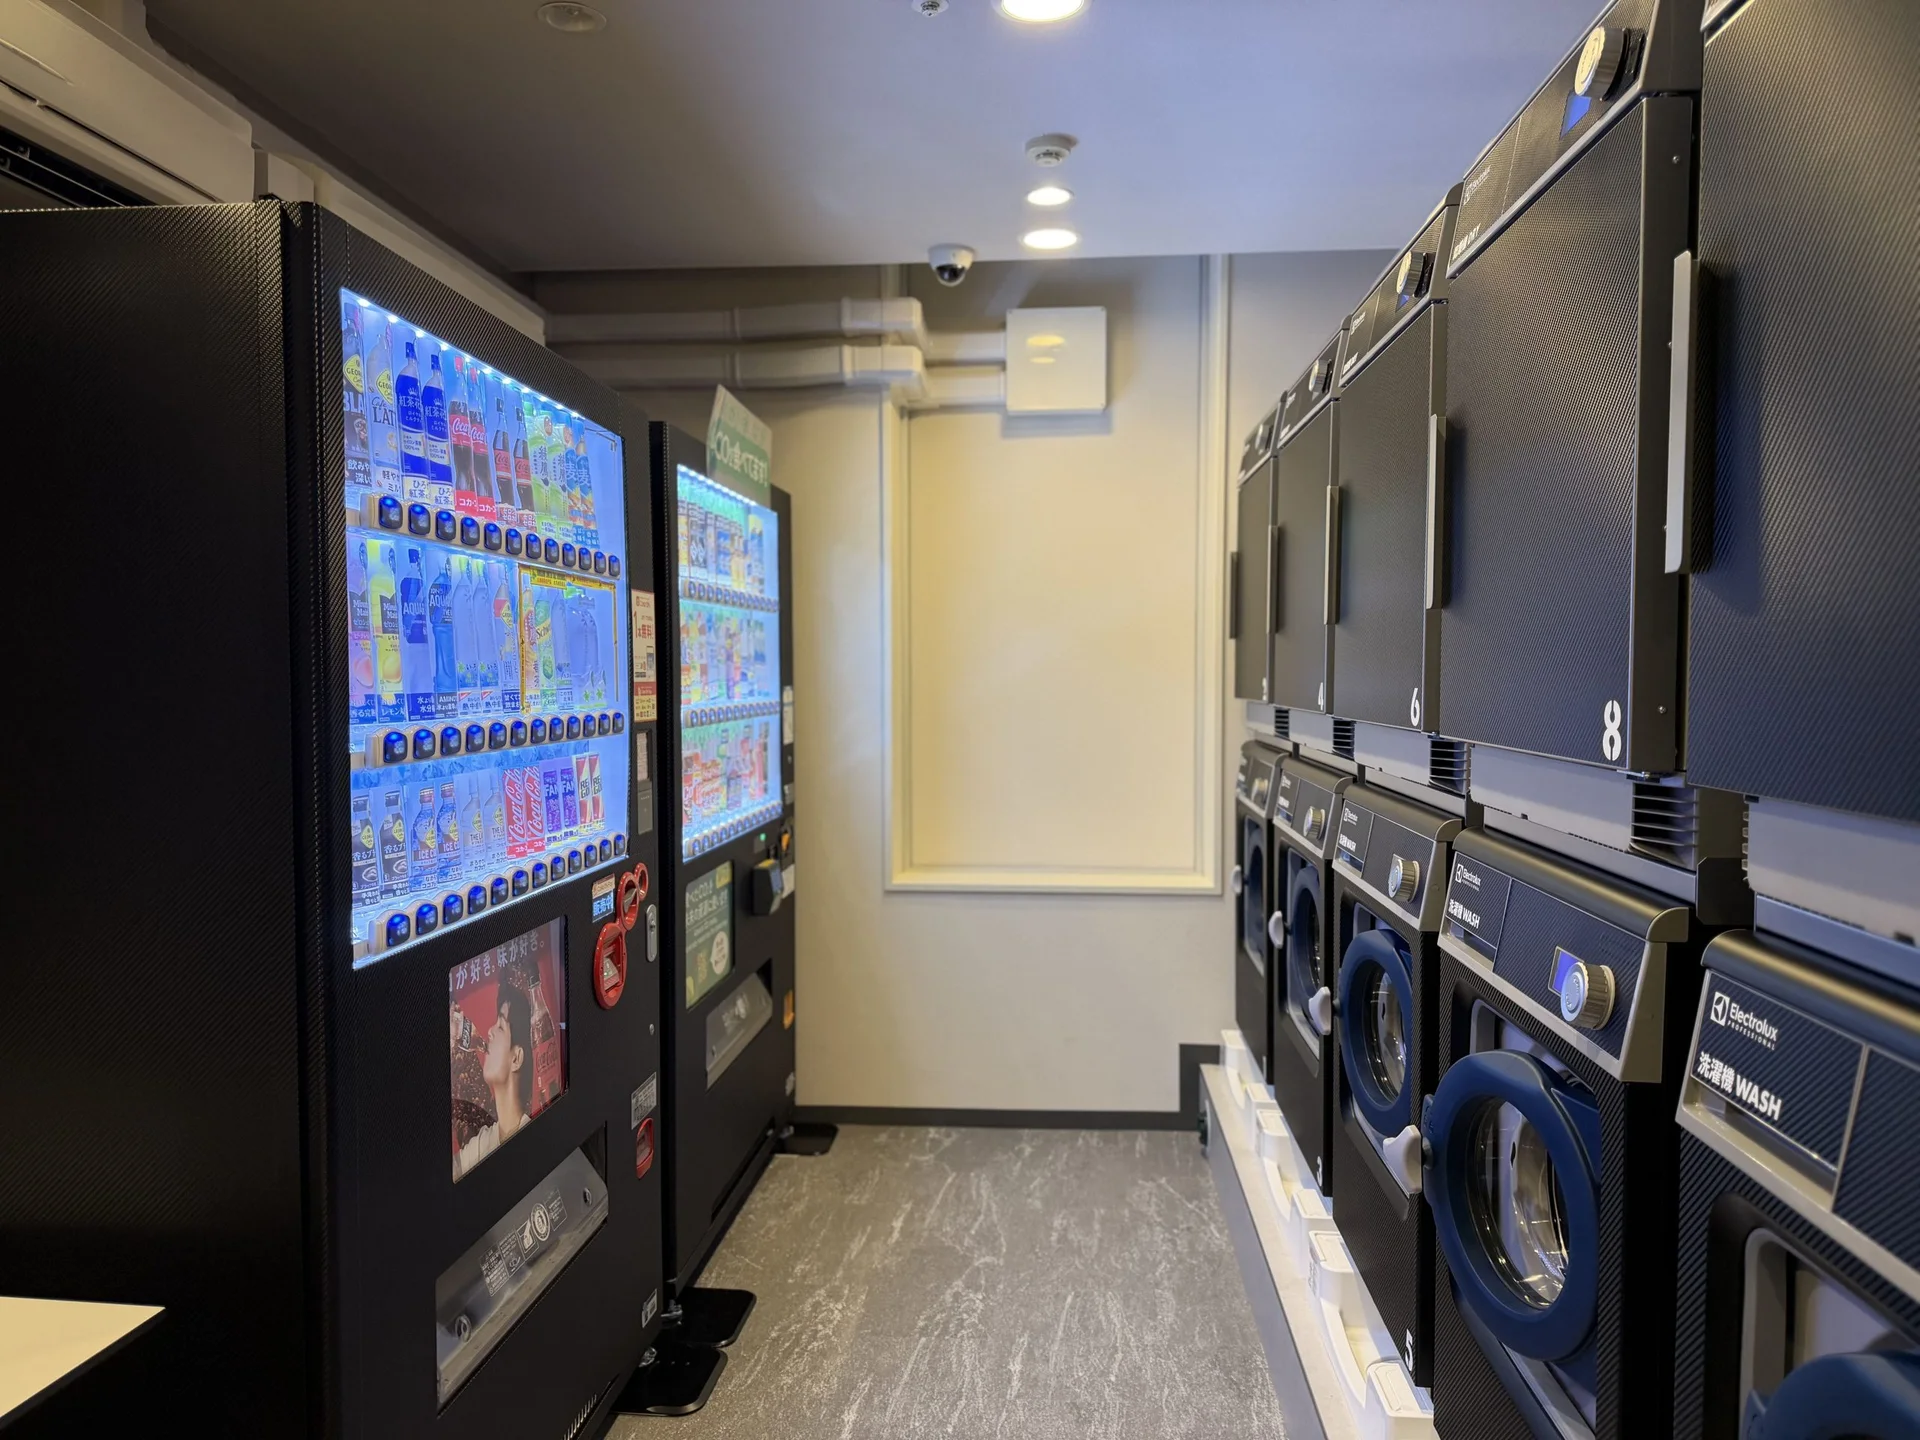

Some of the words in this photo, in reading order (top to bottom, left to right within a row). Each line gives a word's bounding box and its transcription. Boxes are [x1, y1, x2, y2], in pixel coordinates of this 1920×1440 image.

[1410, 687, 1421, 727] 6
[1602, 699, 1622, 762] 8
[1463, 907, 1481, 929] WASH
[1727, 1020, 1776, 1051] PROFESSIONAL
[1729, 1002, 1779, 1042] Electrolux
[1697, 1051, 1735, 1094] 洗濯機
[1735, 1074, 1783, 1121] WASH
[1316, 1156, 1323, 1187] 3
[1405, 1328, 1414, 1372] 5
